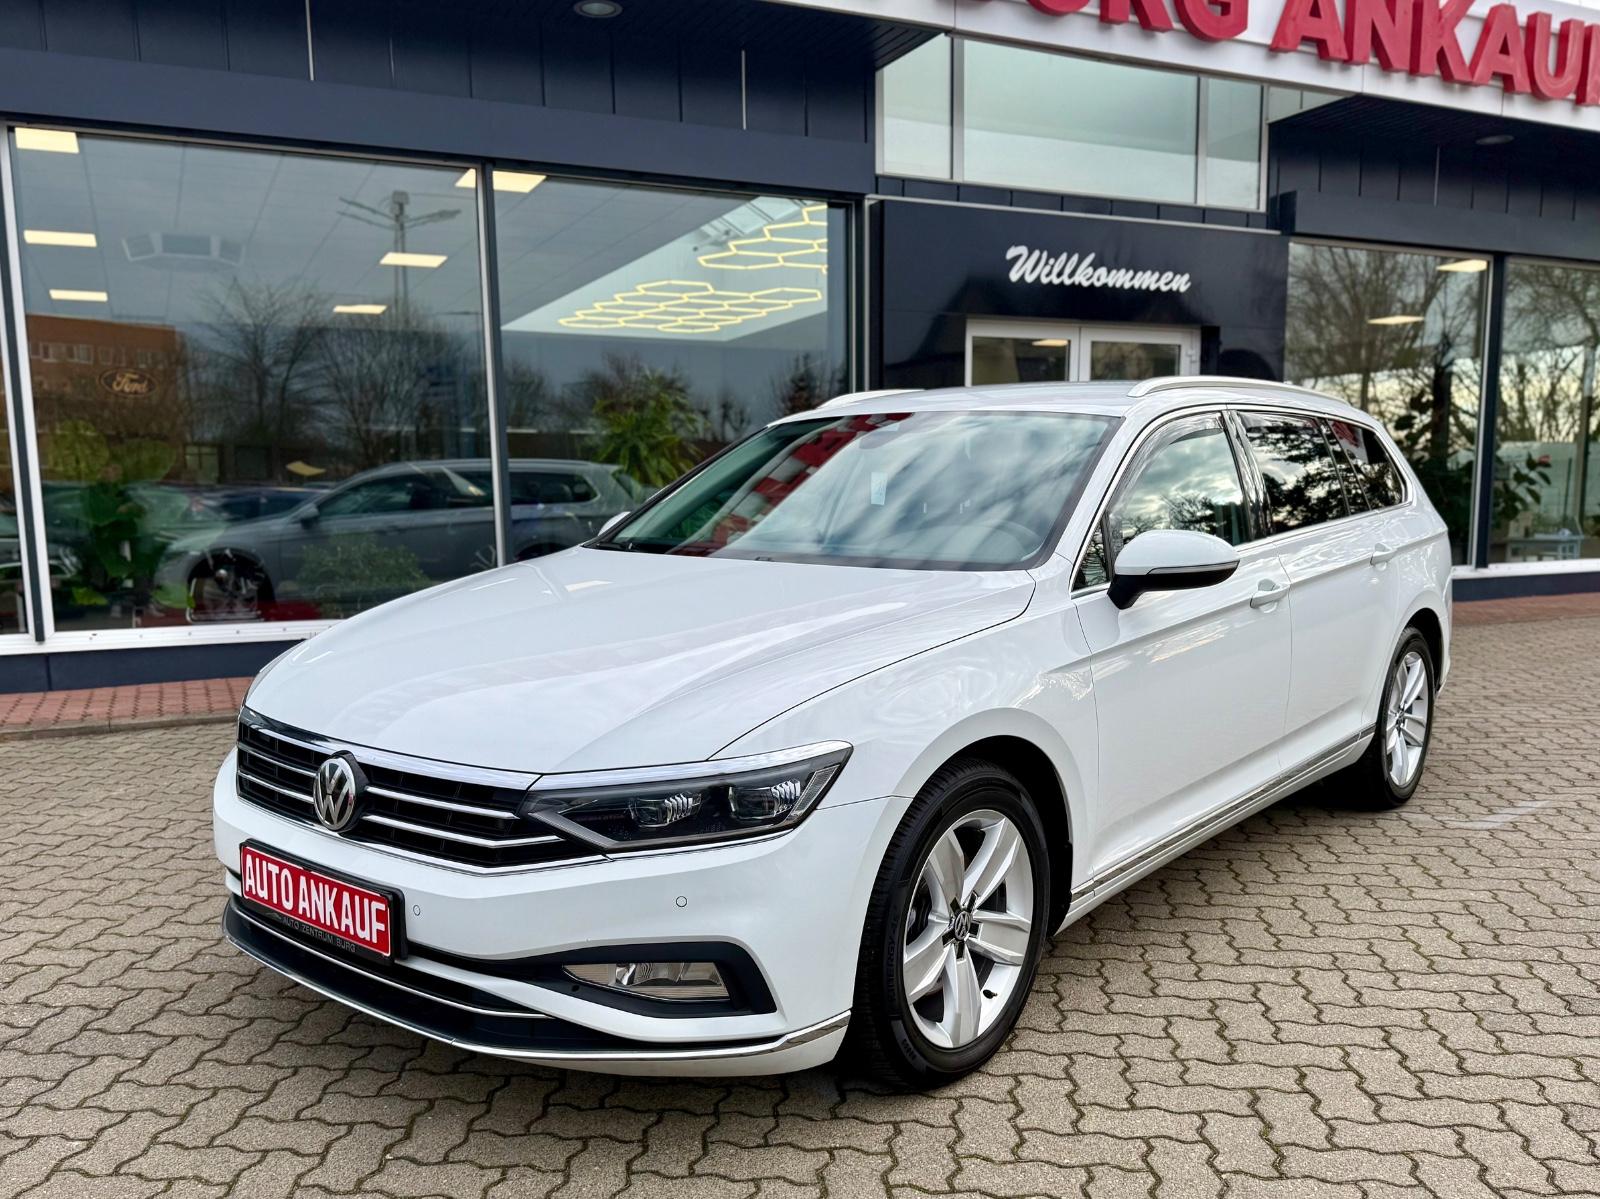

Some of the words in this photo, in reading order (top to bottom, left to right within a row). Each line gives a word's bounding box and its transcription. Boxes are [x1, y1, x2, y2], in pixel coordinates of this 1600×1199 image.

[1270, 0, 1600, 105] ANKAU
[1005, 244, 1192, 293] Willkommen
[112, 372, 148, 393] Ford
[245, 854, 293, 911] AUTO
[298, 875, 386, 944] ANKAUF
[301, 924, 334, 944] ZENTRUM
